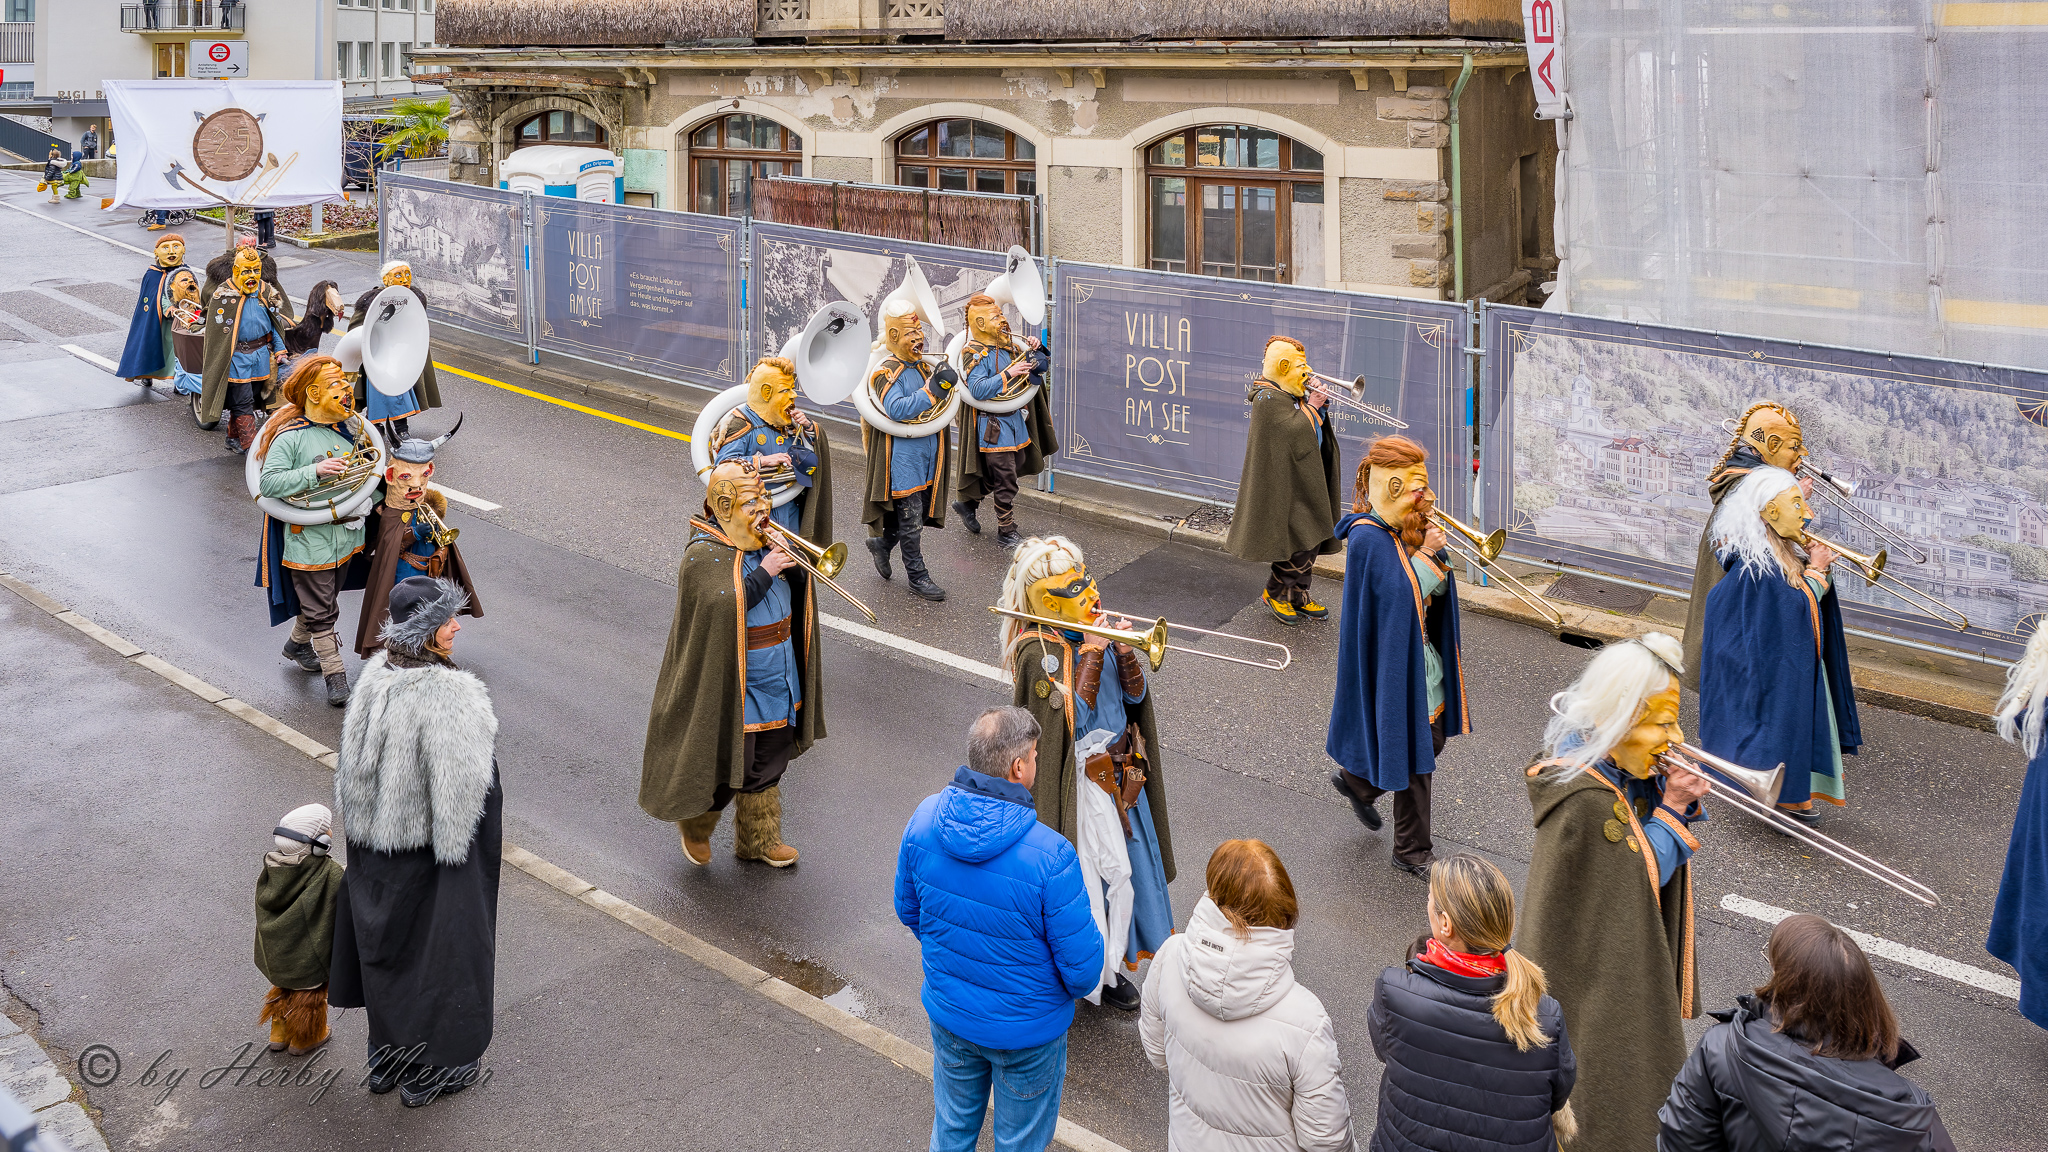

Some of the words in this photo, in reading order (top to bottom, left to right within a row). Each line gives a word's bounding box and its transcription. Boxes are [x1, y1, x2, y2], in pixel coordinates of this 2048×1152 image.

[57, 90, 86, 99] RIGI
[212, 127, 250, 155] 25
[567, 230, 602, 260] VILLA
[569, 261, 602, 293] POST
[629, 280, 666, 294] Vergangenheit,
[666, 287, 675, 295] ein
[675, 289, 692, 298] Leben
[640, 272, 659, 283] braucht
[659, 276, 674, 286] Liebe
[569, 293, 585, 316] AM
[587, 296, 603, 320] SEE
[629, 290, 637, 298] im
[637, 291, 652, 301] Heute
[652, 295, 662, 303] und
[662, 295, 683, 307] Neugier
[684, 300, 694, 308] auf
[1125, 311, 1191, 353] VILLA
[1125, 353, 1191, 397] POST
[1125, 397, 1154, 429] AM
[1161, 402, 1191, 434] SEE
[1327, 410, 1360, 424] erden,
